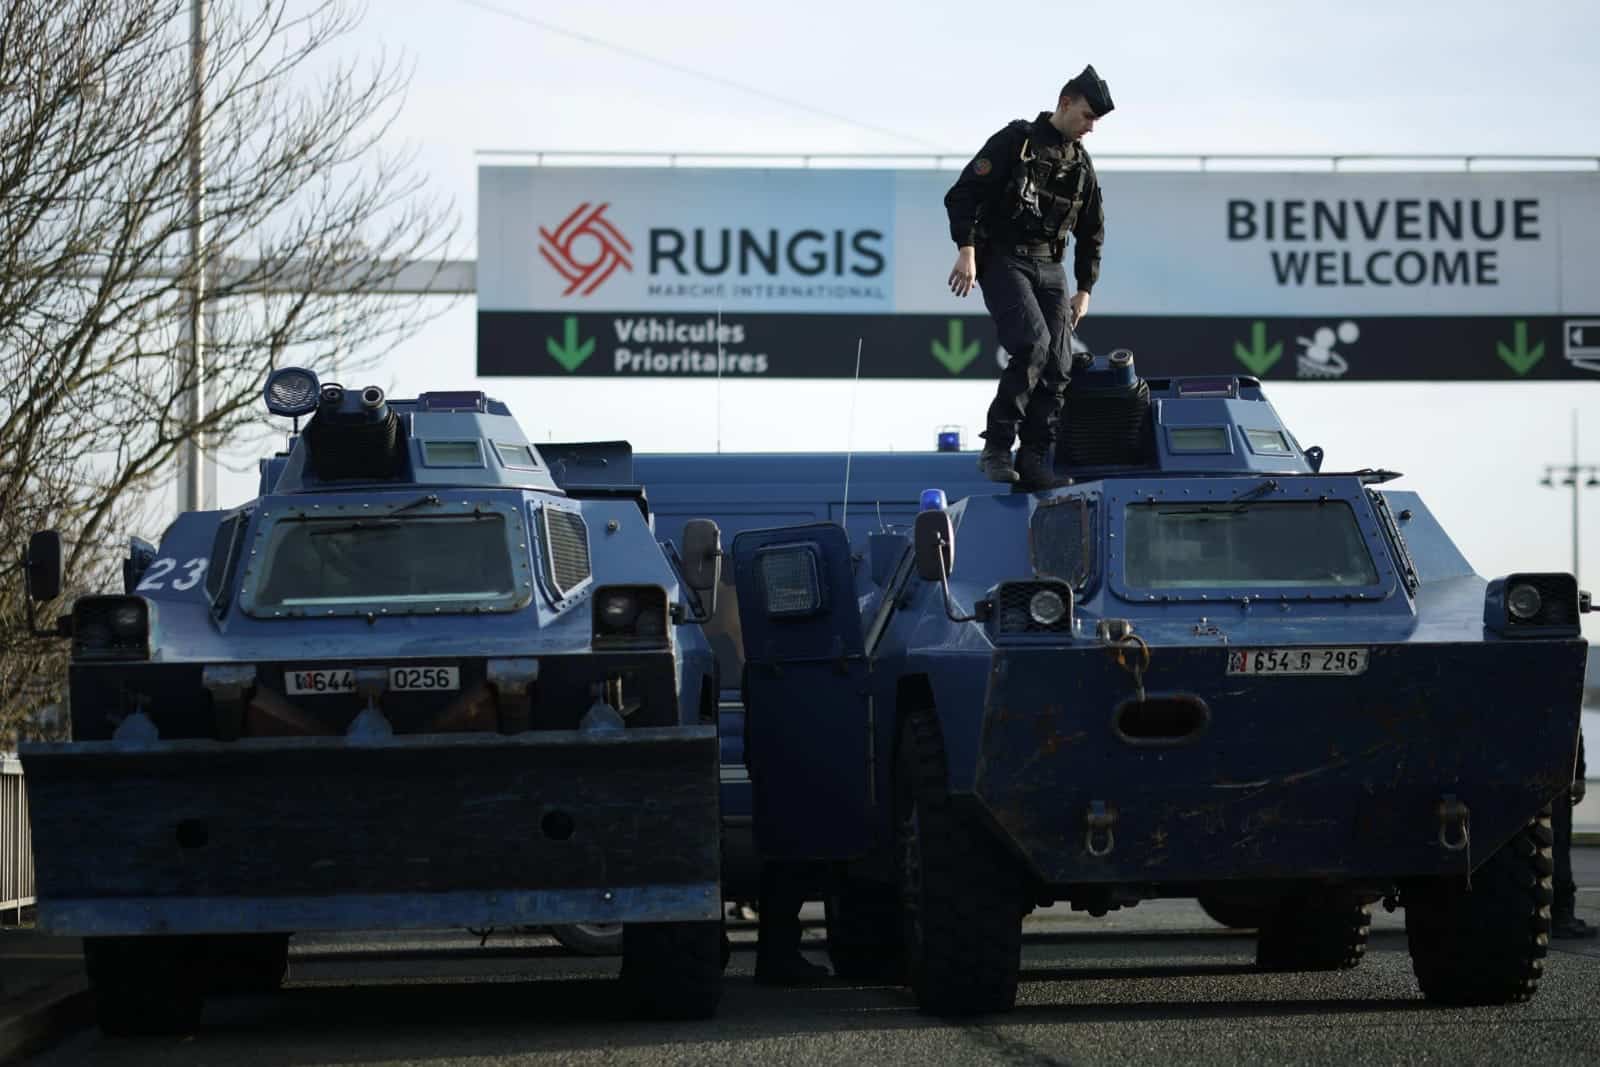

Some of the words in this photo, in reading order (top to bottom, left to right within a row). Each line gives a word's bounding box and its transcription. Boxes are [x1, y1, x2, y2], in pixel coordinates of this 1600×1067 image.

[1227, 199, 1540, 240] BIENVENUE
[649, 228, 886, 277] RUNGIS
[1271, 249, 1499, 286] WELCOME
[647, 283, 724, 297] MARCHÉ
[731, 285, 885, 299] INTERNATIONAL
[614, 318, 744, 343] Véhicules
[614, 347, 768, 372] Prioritaires
[136, 557, 208, 590] 23
[394, 669, 449, 689] 0256
